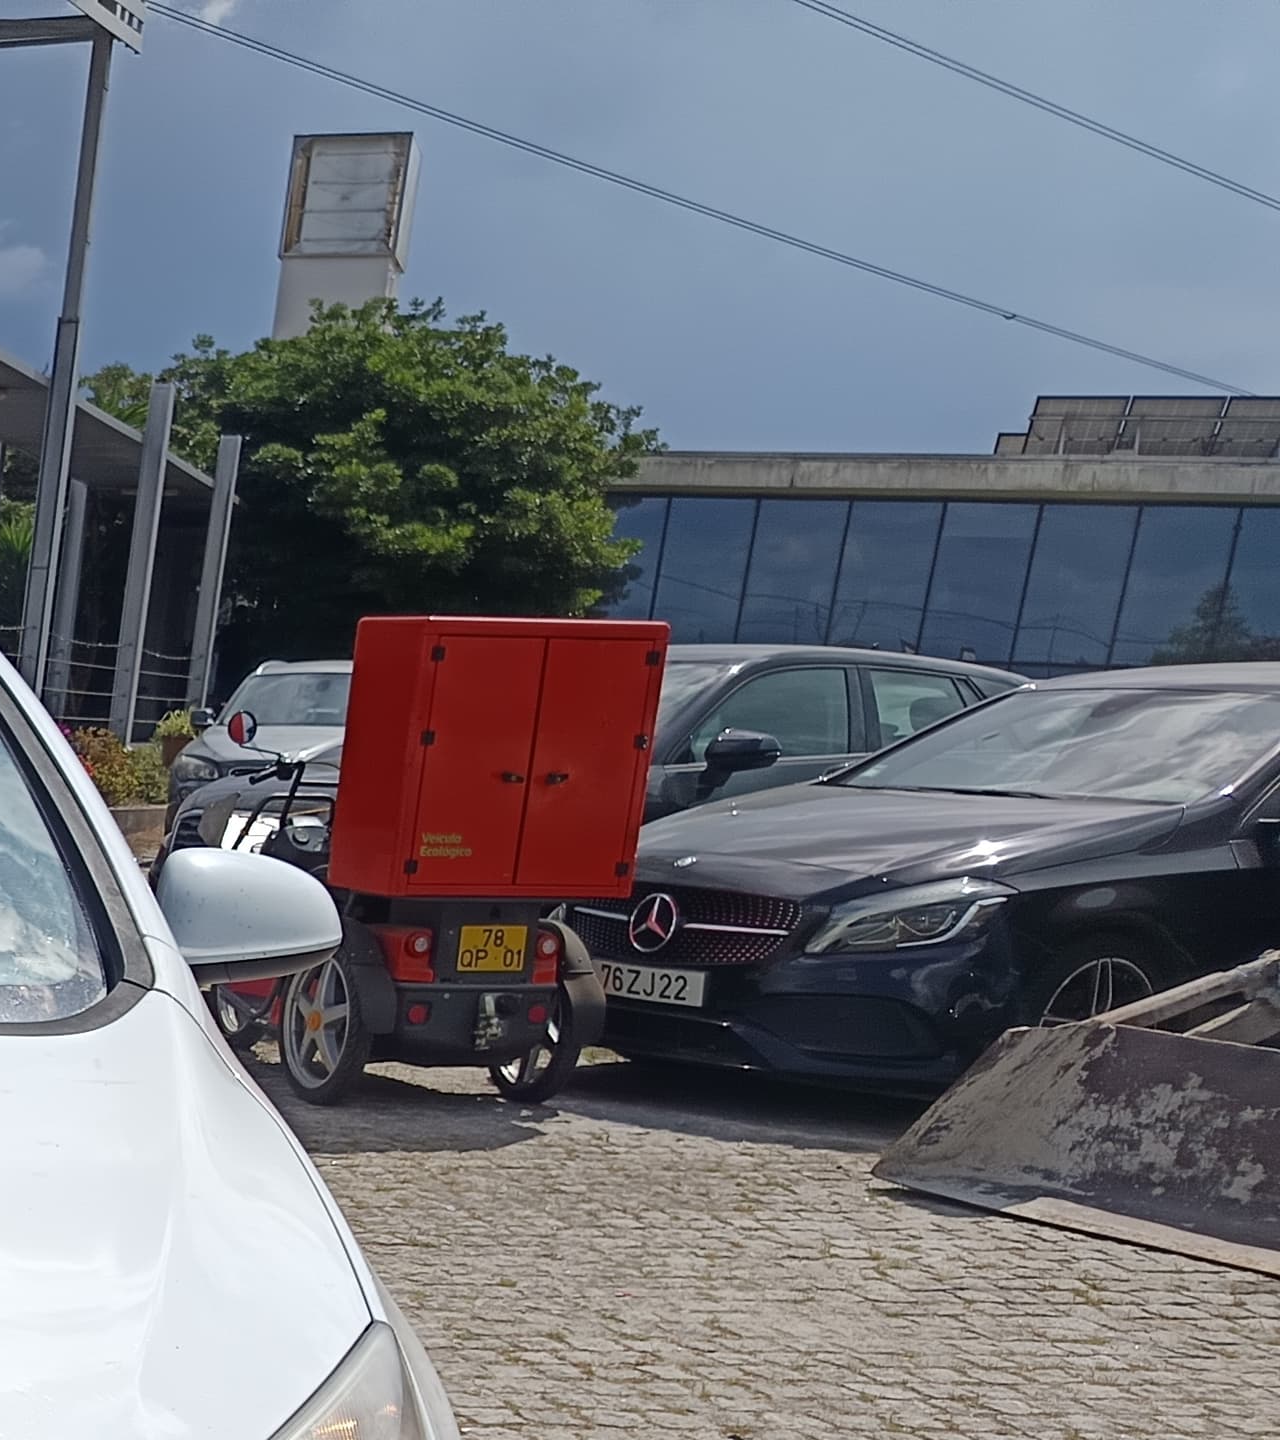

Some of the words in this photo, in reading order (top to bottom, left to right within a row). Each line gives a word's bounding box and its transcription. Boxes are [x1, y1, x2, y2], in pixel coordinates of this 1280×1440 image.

[482, 929, 504, 947] 78
[460, 949, 488, 968] QP
[503, 949, 522, 968] 01
